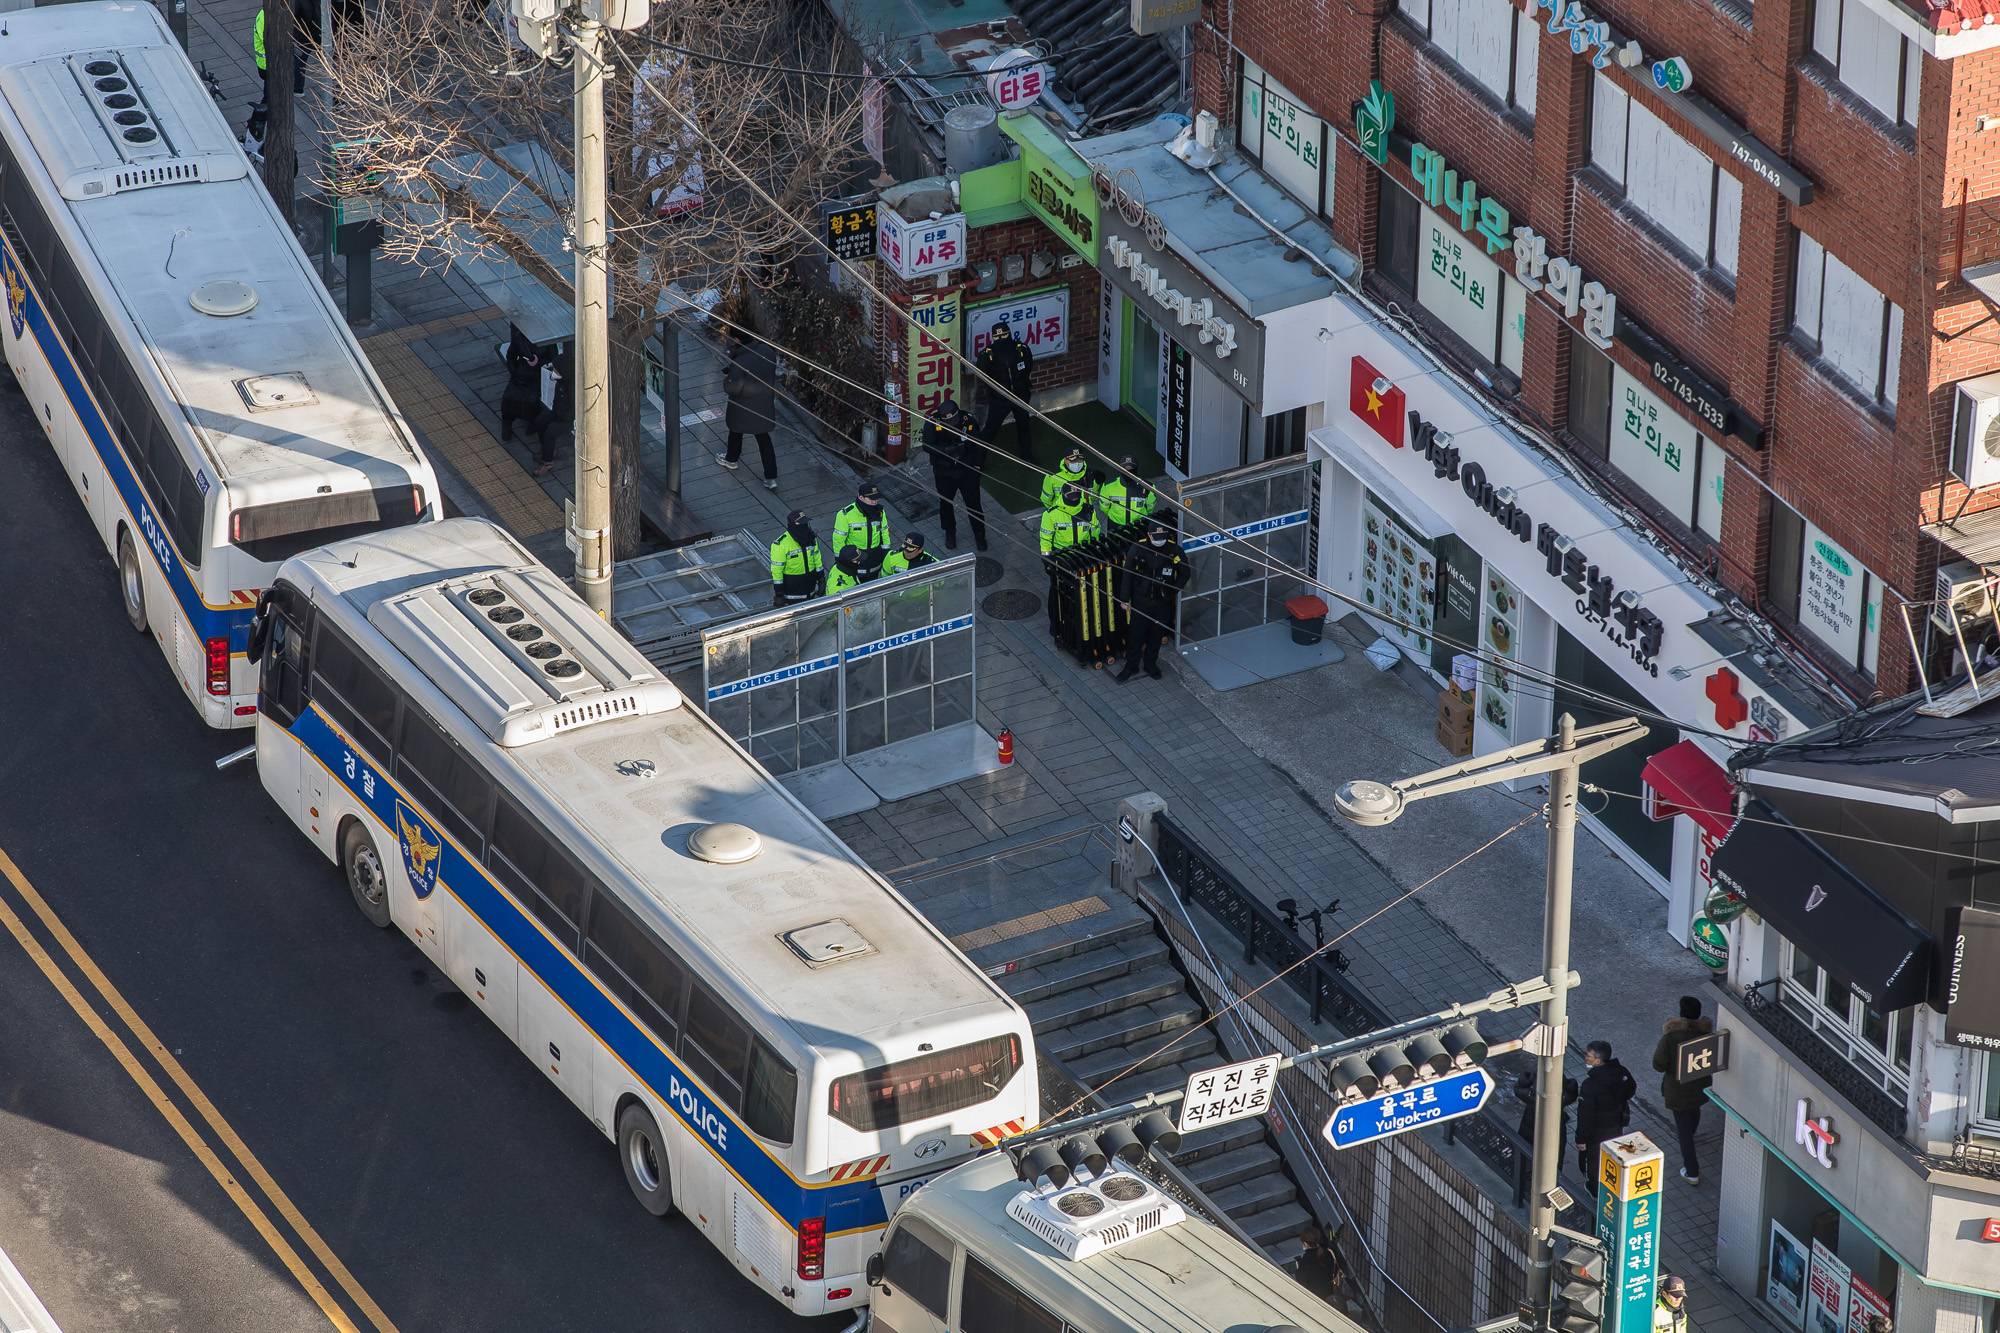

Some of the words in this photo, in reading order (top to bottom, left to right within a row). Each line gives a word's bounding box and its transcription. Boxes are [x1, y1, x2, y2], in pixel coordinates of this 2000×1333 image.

[1148, 0, 1197, 20] 743-7533
[1000, 71, 1042, 104] 타로
[1268, 92, 1296, 122] 대나무
[1267, 110, 1318, 169] 한의원
[1731, 141, 1781, 187] 747-0443
[885, 221, 898, 238] 사주
[924, 229, 947, 243] 타로
[1411, 142, 1512, 255] 대나무
[1513, 226, 1616, 350] 한의원
[1432, 227, 1462, 262] 대나무
[881, 230, 901, 265] 타로
[915, 240, 957, 266] 사주
[1431, 248, 1485, 310] 한의원
[1175, 363, 1185, 408] 대나무
[1654, 362, 1725, 428] 02-743-7533
[1626, 387, 1658, 422] 대나무
[1625, 408, 1681, 473] 한의원
[141, 502, 171, 574] POLICE
[1259, 517, 1286, 531] LINE
[1818, 541, 1850, 575] 진료과목
[869, 631, 918, 653] POLICE
[925, 621, 954, 637] LINE
[1575, 599, 1659, 678] 02-744-1868
[731, 672, 780, 692] POLICE
[787, 662, 816, 678] LINE
[1718, 812, 1745, 848] GUINNESS
[409, 866, 428, 891] POLICE
[1948, 934, 1966, 1005] GUINNESS
[1851, 981, 1873, 1003] momiji
[1957, 1033, 1983, 1046] 생맥주
[1687, 1048, 1713, 1074] kt
[1187, 1088, 1267, 1124] 직좌신호
[1380, 1086, 1438, 1118] 율곡로
[1461, 1082, 1480, 1100] 65
[670, 1074, 727, 1151] POLICE
[1338, 1117, 1354, 1135] 61
[1375, 1107, 1442, 1133] Yulgok-ro
[1795, 1099, 1836, 1169] kt
[1605, 1192, 1614, 1210] 2
[1637, 1199, 1649, 1216] 2
[1627, 1234, 1643, 1270] 안국
[1813, 1262, 1841, 1294] 버즈3프로
[1811, 1273, 1840, 1317] 득템
